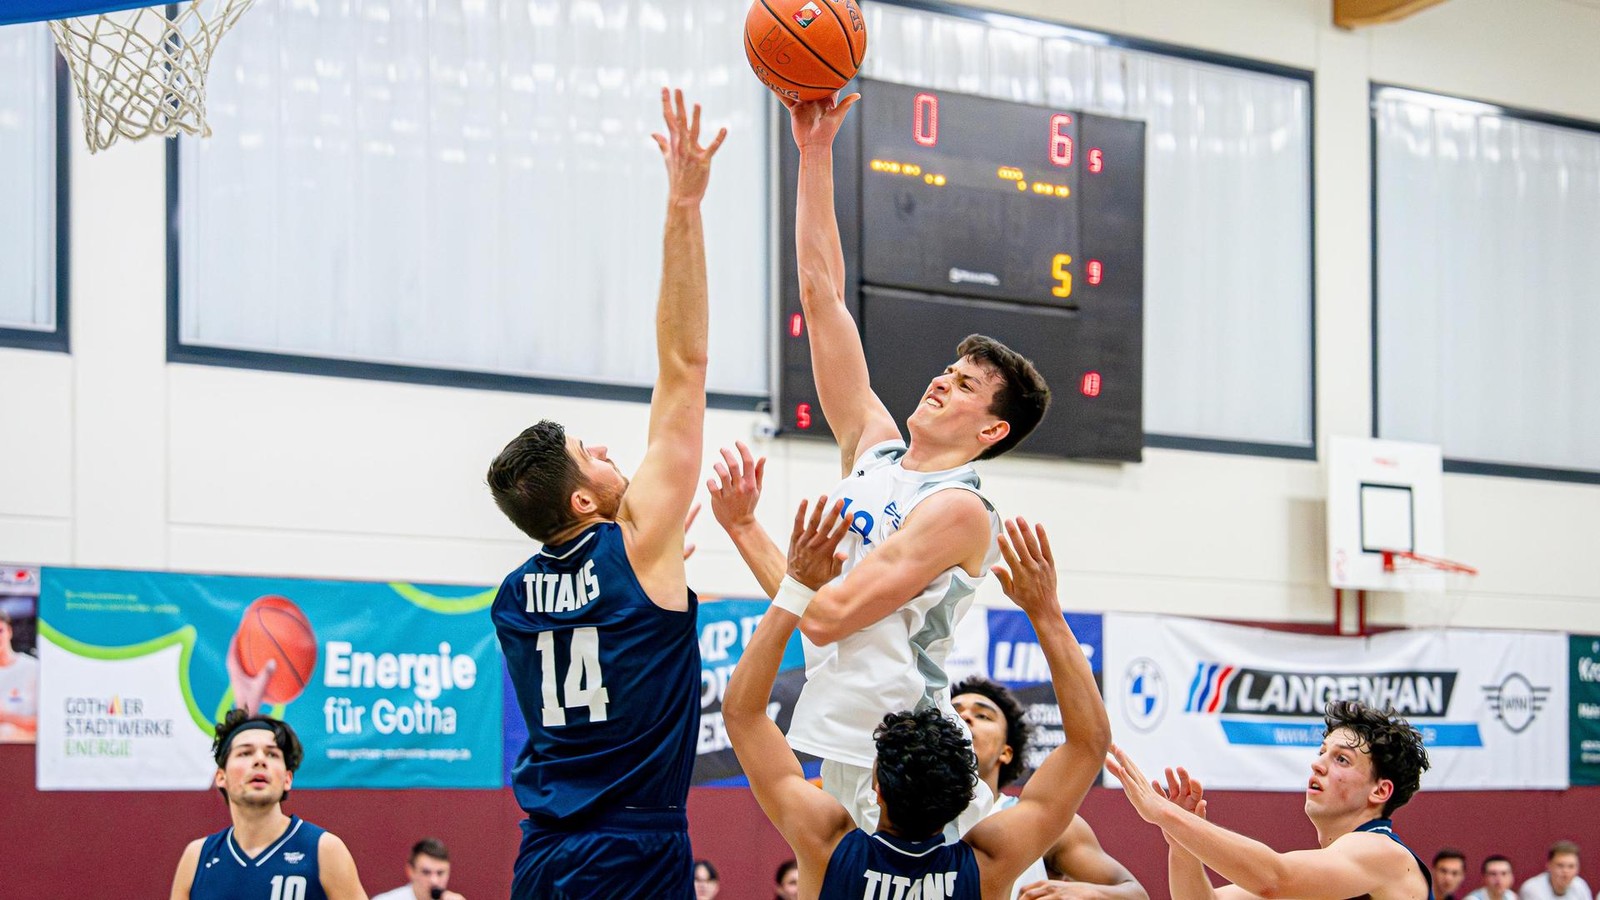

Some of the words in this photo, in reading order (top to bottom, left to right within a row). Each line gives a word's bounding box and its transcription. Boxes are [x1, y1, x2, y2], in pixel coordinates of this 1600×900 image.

[913, 93, 938, 147] 0
[1050, 113, 1073, 166] 6
[1088, 148, 1103, 173] 5
[1052, 253, 1072, 297] 5
[797, 403, 811, 429] 5
[523, 559, 600, 613] TITANS
[323, 641, 477, 700] Energie
[536, 626, 610, 727] 14
[65, 694, 144, 715] GOTHAER
[1236, 674, 1444, 713] LANGENHAN
[65, 719, 174, 737] STADTWERKE
[323, 696, 366, 735] für
[371, 698, 458, 735] Gotha
[65, 739, 133, 757] ENERGIE
[270, 875, 307, 900] 10
